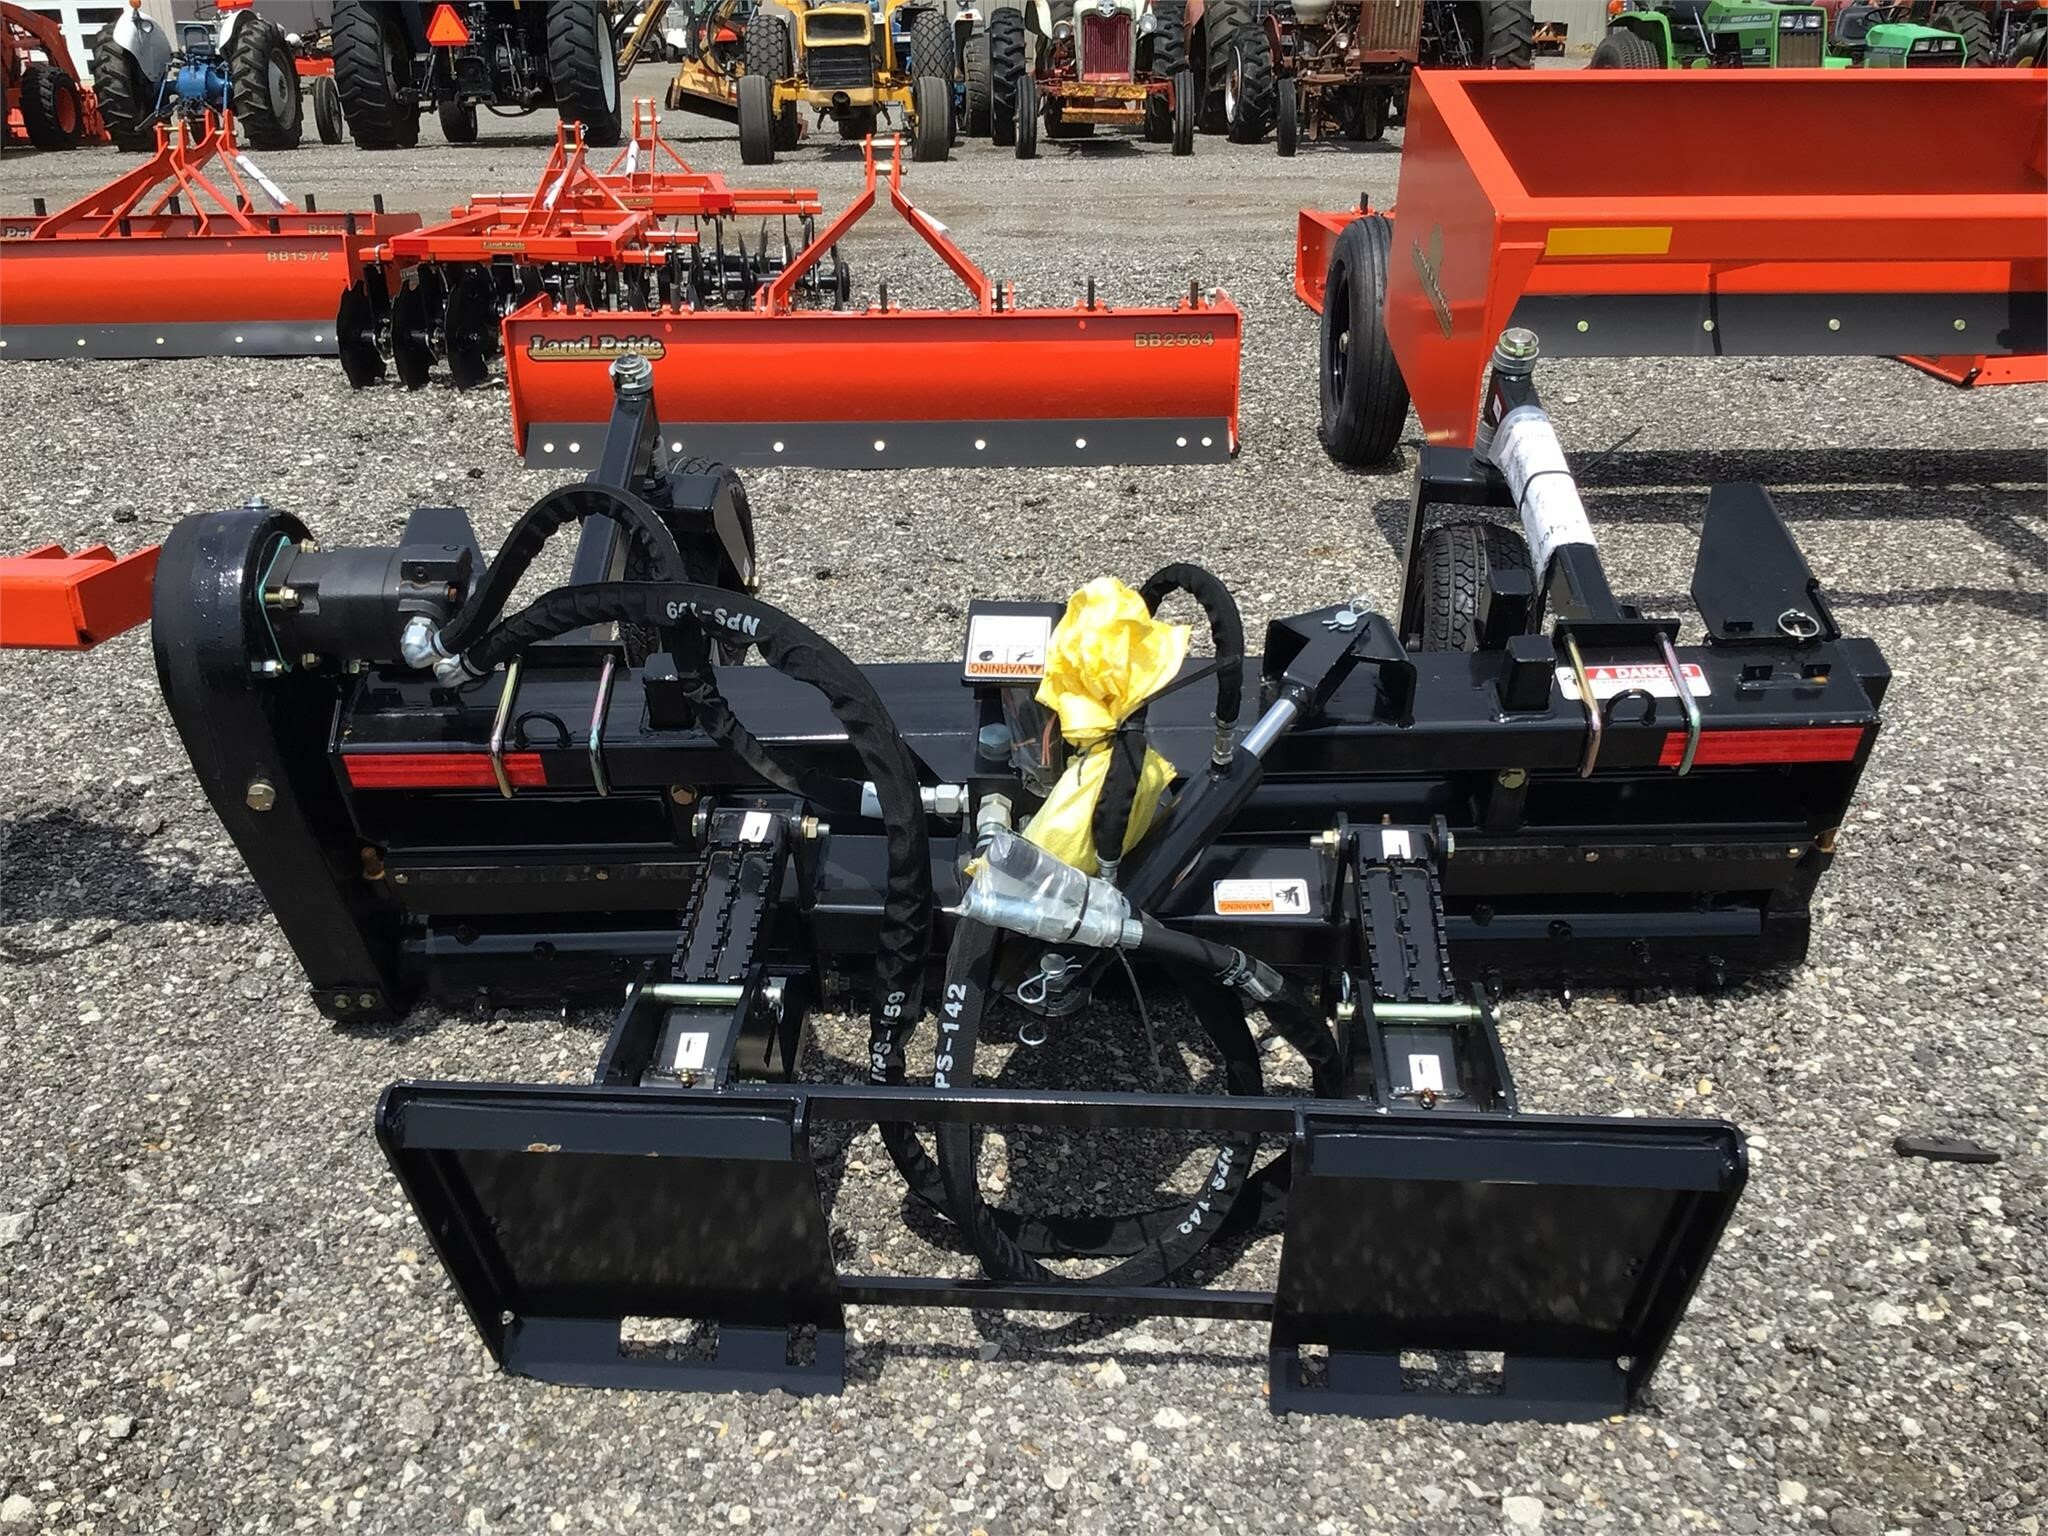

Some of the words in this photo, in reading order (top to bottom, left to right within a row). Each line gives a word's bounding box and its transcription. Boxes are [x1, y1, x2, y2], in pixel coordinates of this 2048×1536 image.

[308, 224, 364, 235] BB152
[266, 249, 329, 261] BB1572
[530, 336, 590, 353] Land
[599, 335, 663, 353] Pride
[1134, 332, 1215, 348] BB2584
[970, 664, 1029, 674] WARNING
[1615, 666, 1693, 679] DANGR
[1221, 902, 1261, 911] WARNING
